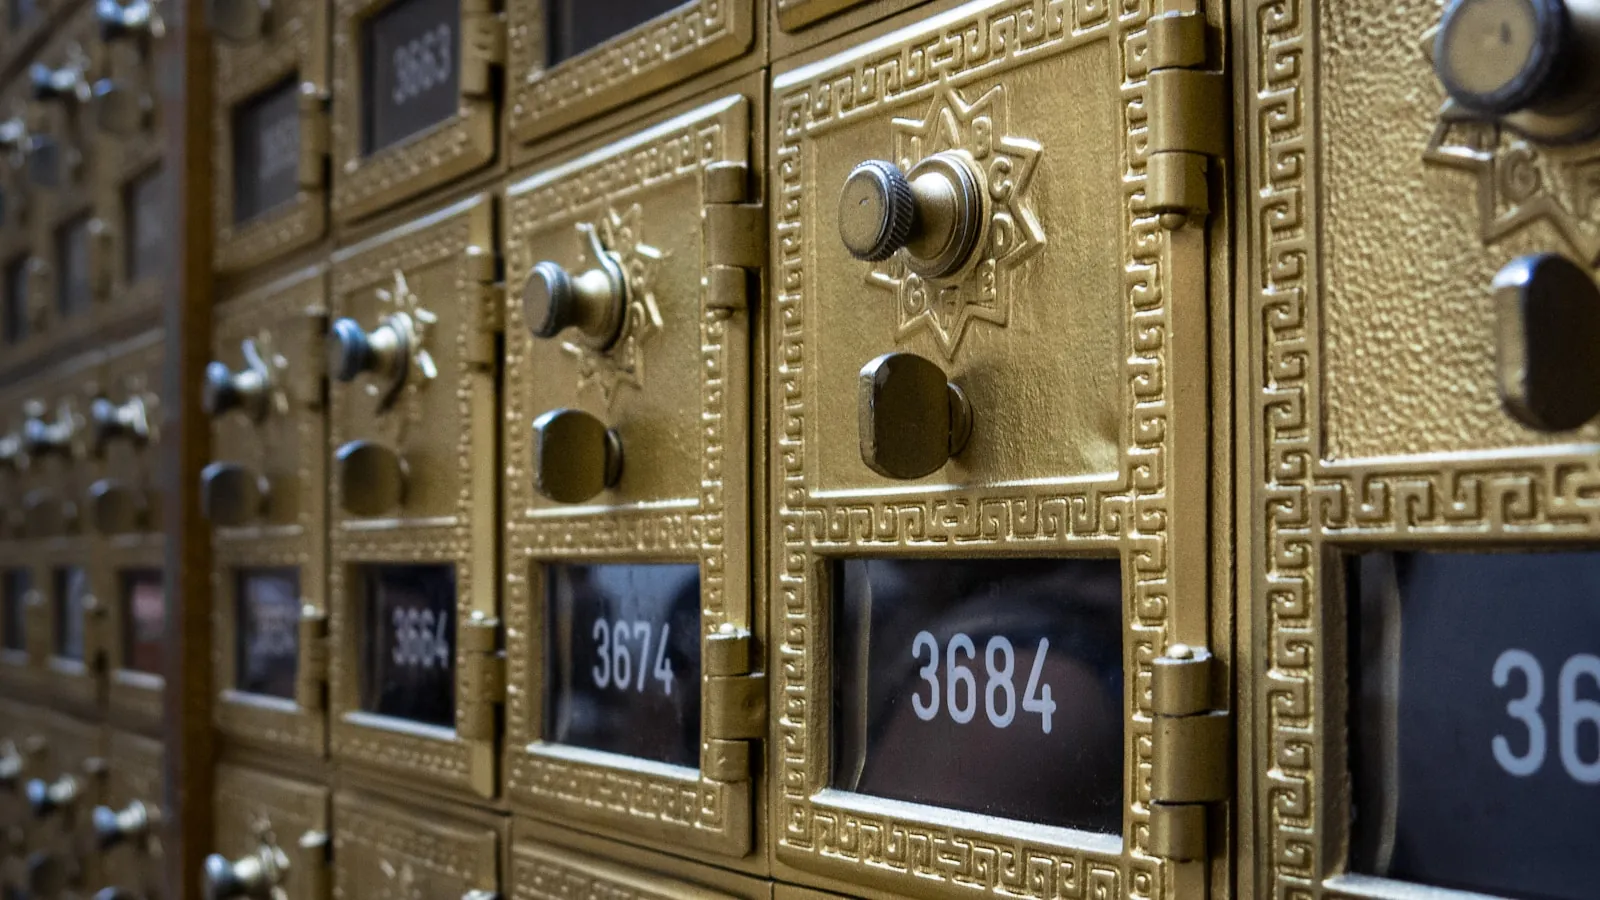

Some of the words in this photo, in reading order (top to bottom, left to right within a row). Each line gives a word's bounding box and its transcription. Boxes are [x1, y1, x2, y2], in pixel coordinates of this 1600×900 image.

[988, 156, 1013, 200] C
[992, 212, 1015, 258] D
[391, 605, 450, 670] 3664
[592, 618, 675, 696] 3674
[911, 630, 1058, 735] 3684
[1491, 649, 1600, 785] 36
